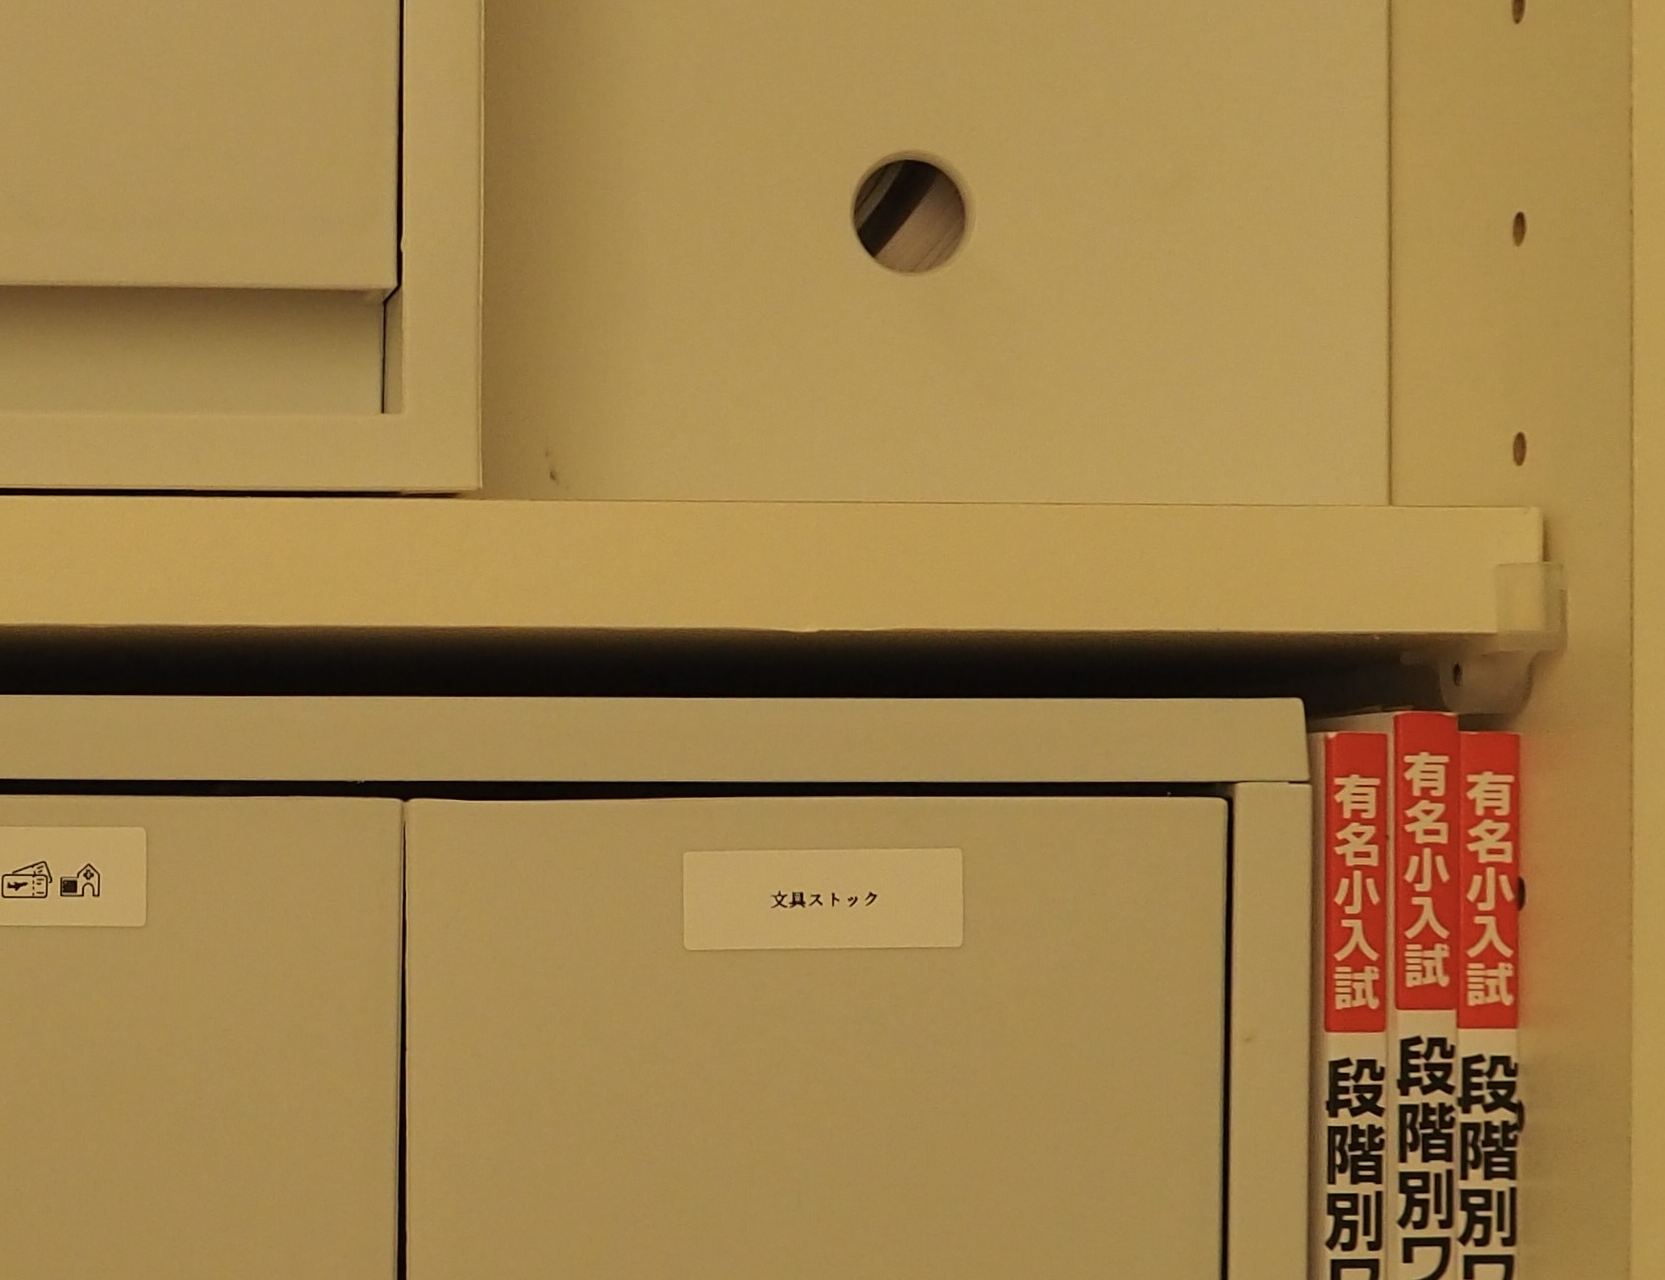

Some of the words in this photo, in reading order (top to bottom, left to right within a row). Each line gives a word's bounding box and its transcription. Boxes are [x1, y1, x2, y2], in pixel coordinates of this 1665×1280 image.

[770, 891, 878, 909] 文具ストック
[1333, 774, 1381, 1010] 有名小入試
[1403, 751, 1450, 988] 有名小入試
[1466, 771, 1515, 1006] 有名小入試
